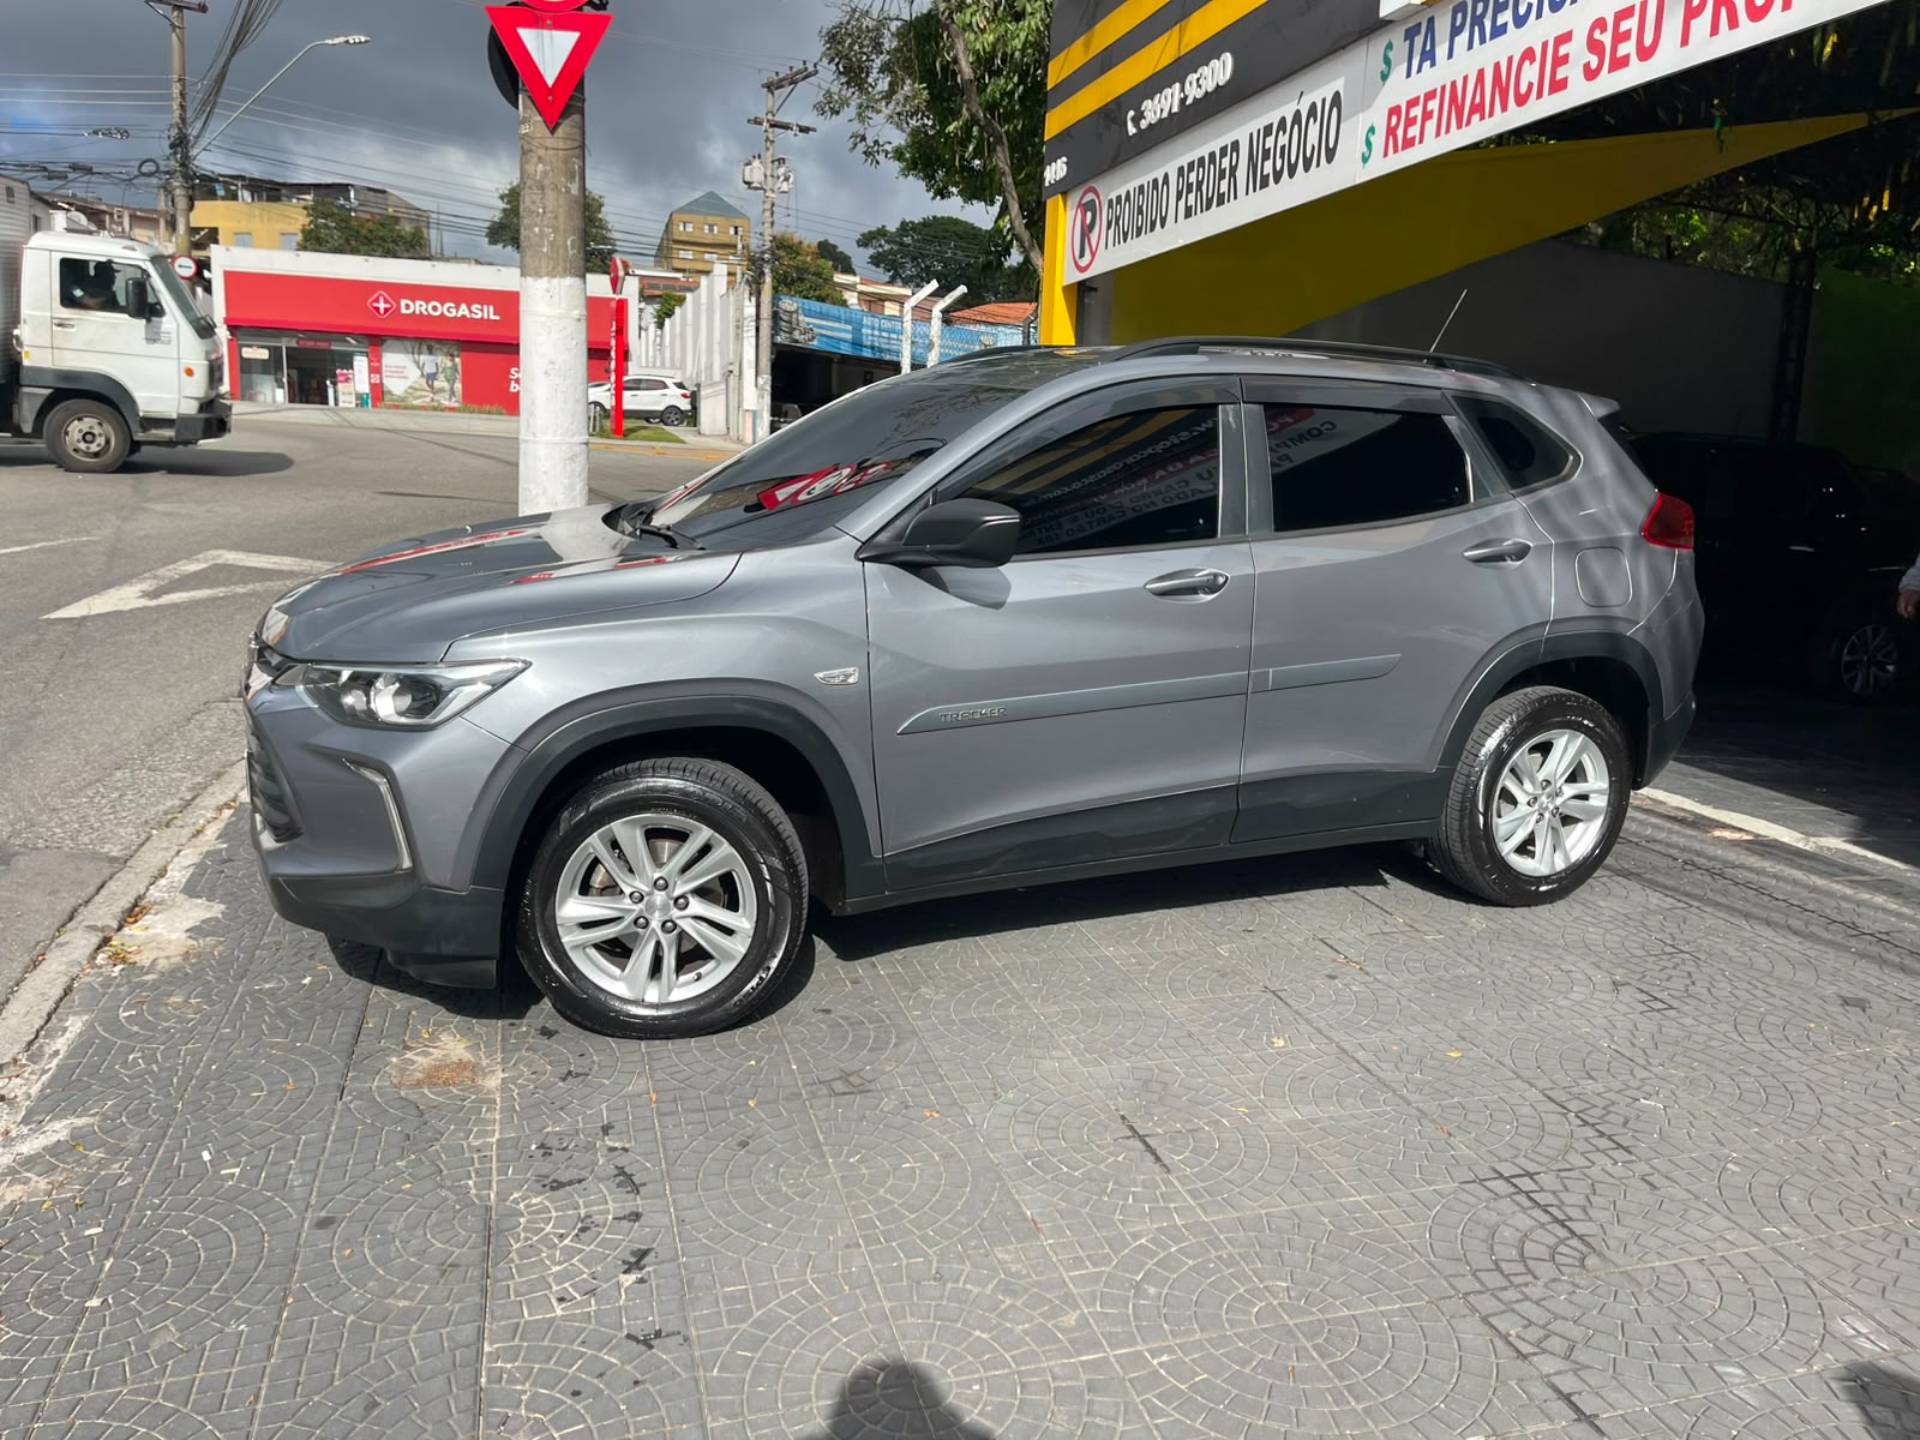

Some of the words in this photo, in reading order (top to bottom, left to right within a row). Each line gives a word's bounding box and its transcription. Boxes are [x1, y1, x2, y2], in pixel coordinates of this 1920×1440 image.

[1383, 30, 1574, 158] REFINANCIE
[1582, 0, 1665, 82] SEU
[1680, 0, 1793, 48] PR
[1403, 15, 1437, 79] TA
[1447, 0, 1578, 60] PREC
[1105, 171, 1170, 250] PROIBIDO
[1174, 138, 1241, 224] PERDER
[1245, 91, 1343, 196] NEGÓCIO
[400, 299, 501, 321] DROGASIL
[938, 705, 1008, 723] TRACKER
